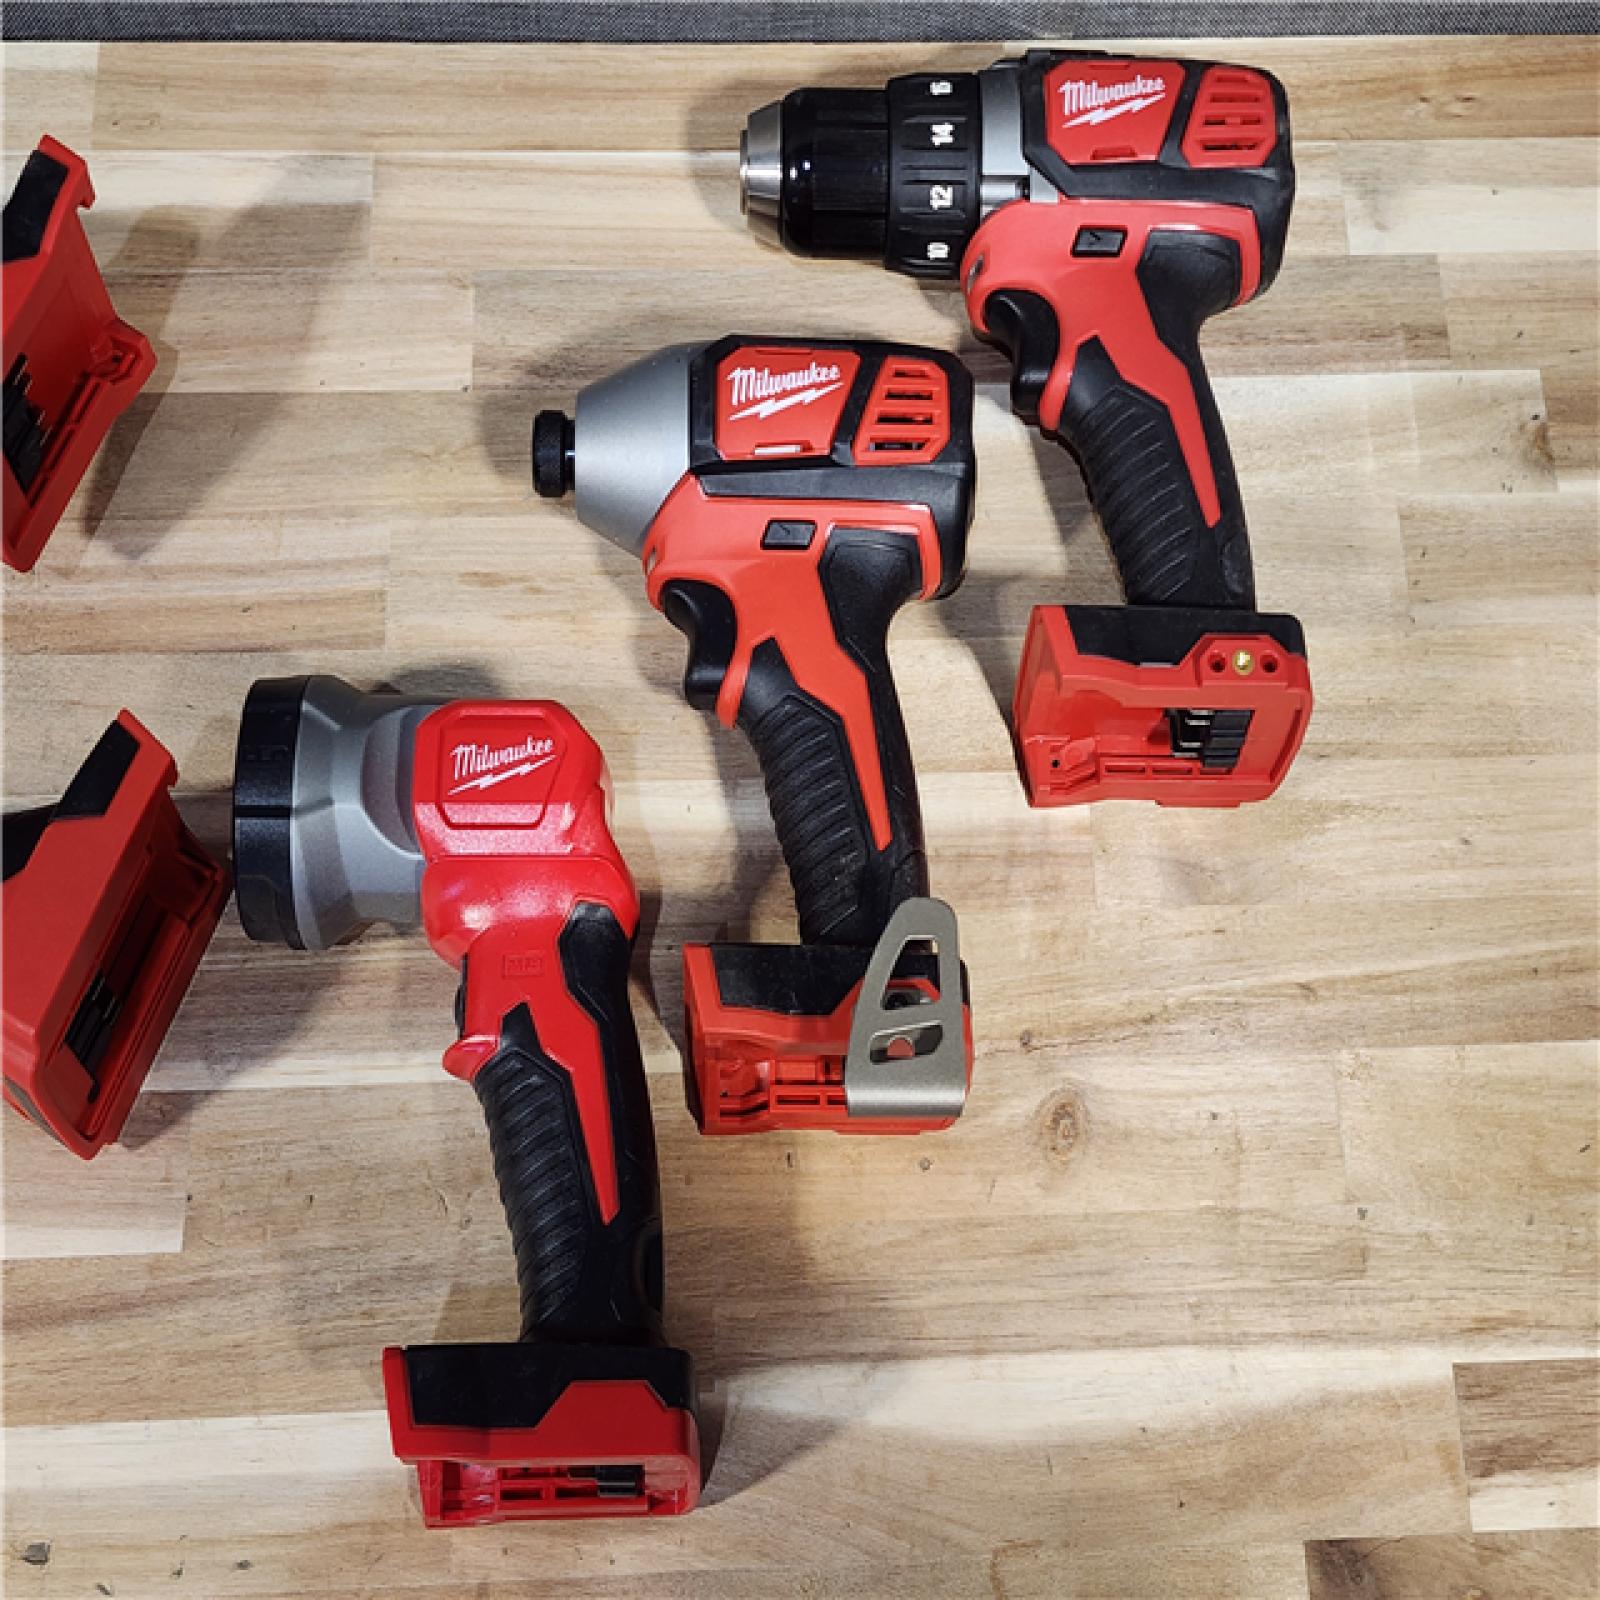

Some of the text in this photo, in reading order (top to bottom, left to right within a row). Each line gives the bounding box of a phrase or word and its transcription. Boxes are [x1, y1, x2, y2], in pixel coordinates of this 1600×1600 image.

[1057, 74, 1166, 116] Milwaukee
[931, 122, 954, 146] 14
[930, 184, 953, 210] 12
[927, 242, 950, 260] 10
[727, 361, 841, 406] Milwaukee
[449, 735, 554, 781] Milwaukee
